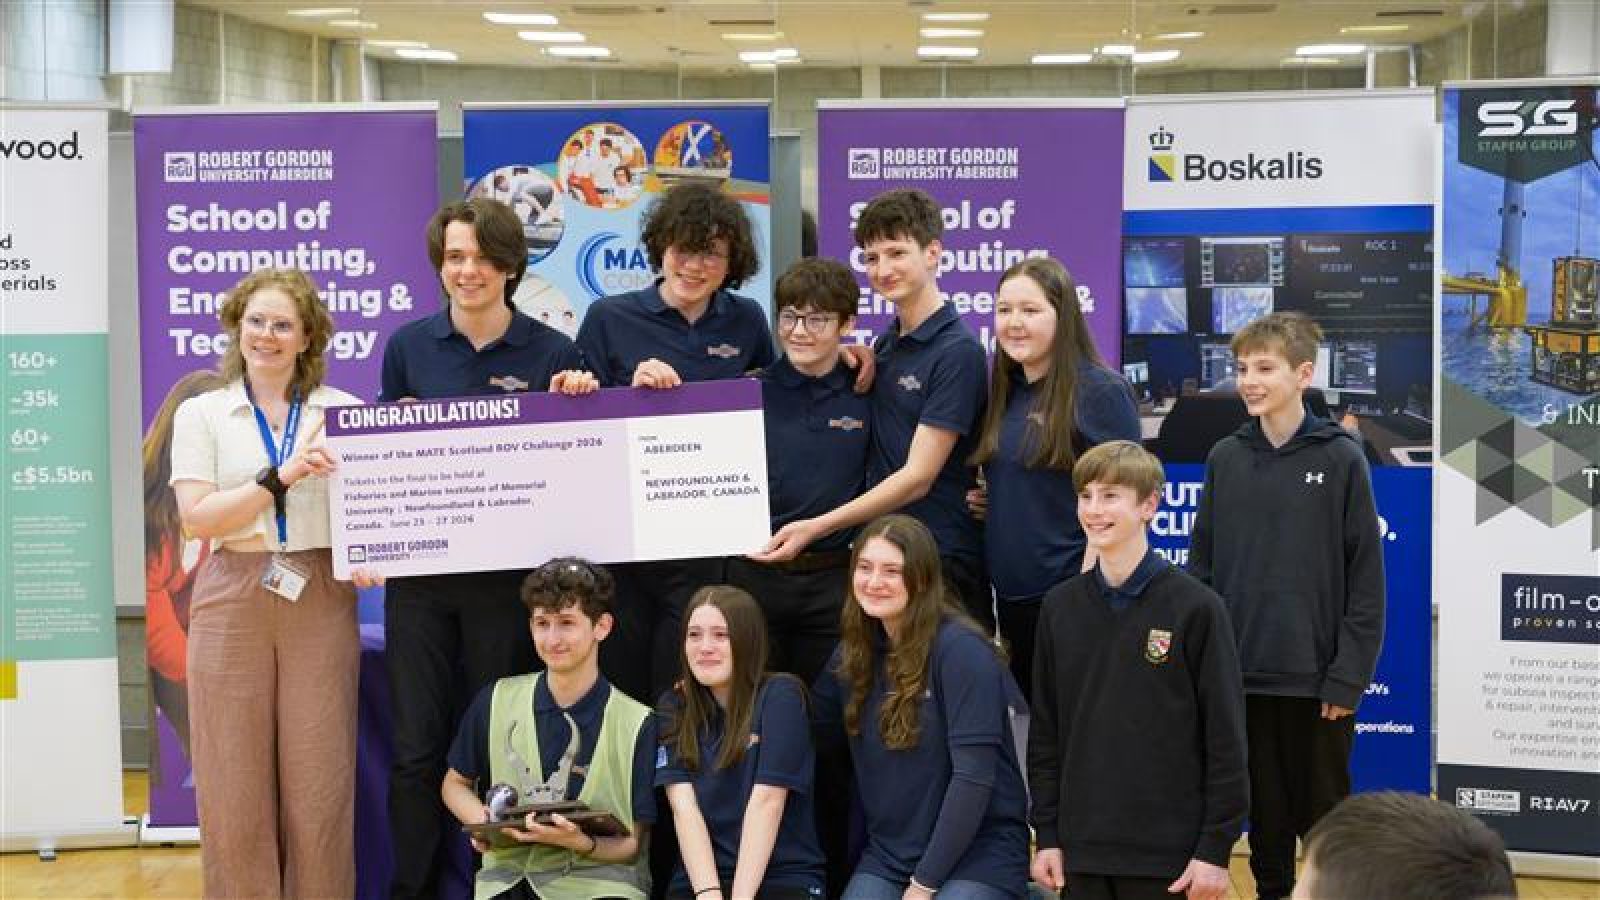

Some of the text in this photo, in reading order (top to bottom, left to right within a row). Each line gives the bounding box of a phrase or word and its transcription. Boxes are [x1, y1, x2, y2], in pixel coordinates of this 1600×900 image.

[1530, 139, 1577, 151] GROUP
[199, 150, 333, 167] ROBERT GORDON
[883, 147, 1019, 165] ROBERT GORDON
[199, 168, 333, 182] UNIVERSITY ABERDEEN
[883, 165, 1019, 180] UNIVERSITY ABERDEEN
[1184, 151, 1323, 182] Boskalis
[167, 201, 332, 232] School of
[977, 199, 1016, 230] of
[168, 240, 376, 277] Computing,
[388, 283, 413, 311] &
[8, 351, 57, 368] 160+
[338, 398, 520, 429] CONGRATULATIONS!
[1541, 403, 1557, 425] &
[11, 429, 50, 445] 60+
[342, 453, 379, 462] Winner
[382, 449, 393, 461] of
[395, 449, 412, 458] the
[415, 447, 445, 457] MATE
[449, 443, 493, 455] Scotland
[521, 439, 573, 451] Challenge
[576, 437, 603, 448] 2026
[644, 443, 703, 455] ABERDEEN
[12, 465, 94, 485] c$5.5bn
[390, 474, 404, 483] the
[406, 473, 427, 482] final
[454, 468, 475, 479] held
[645, 472, 751, 488] NEWFOUNDLAND &
[344, 480, 547, 501] Fisheries and Marine Institute of Memorial
[711, 486, 760, 497] CANADA
[346, 505, 394, 516] University
[405, 499, 475, 512] Newfoundland
[477, 499, 486, 508] &
[367, 540, 448, 554] ROBERT GORDON
[1513, 617, 1577, 629] proven
[1547, 658, 1568, 669] our
